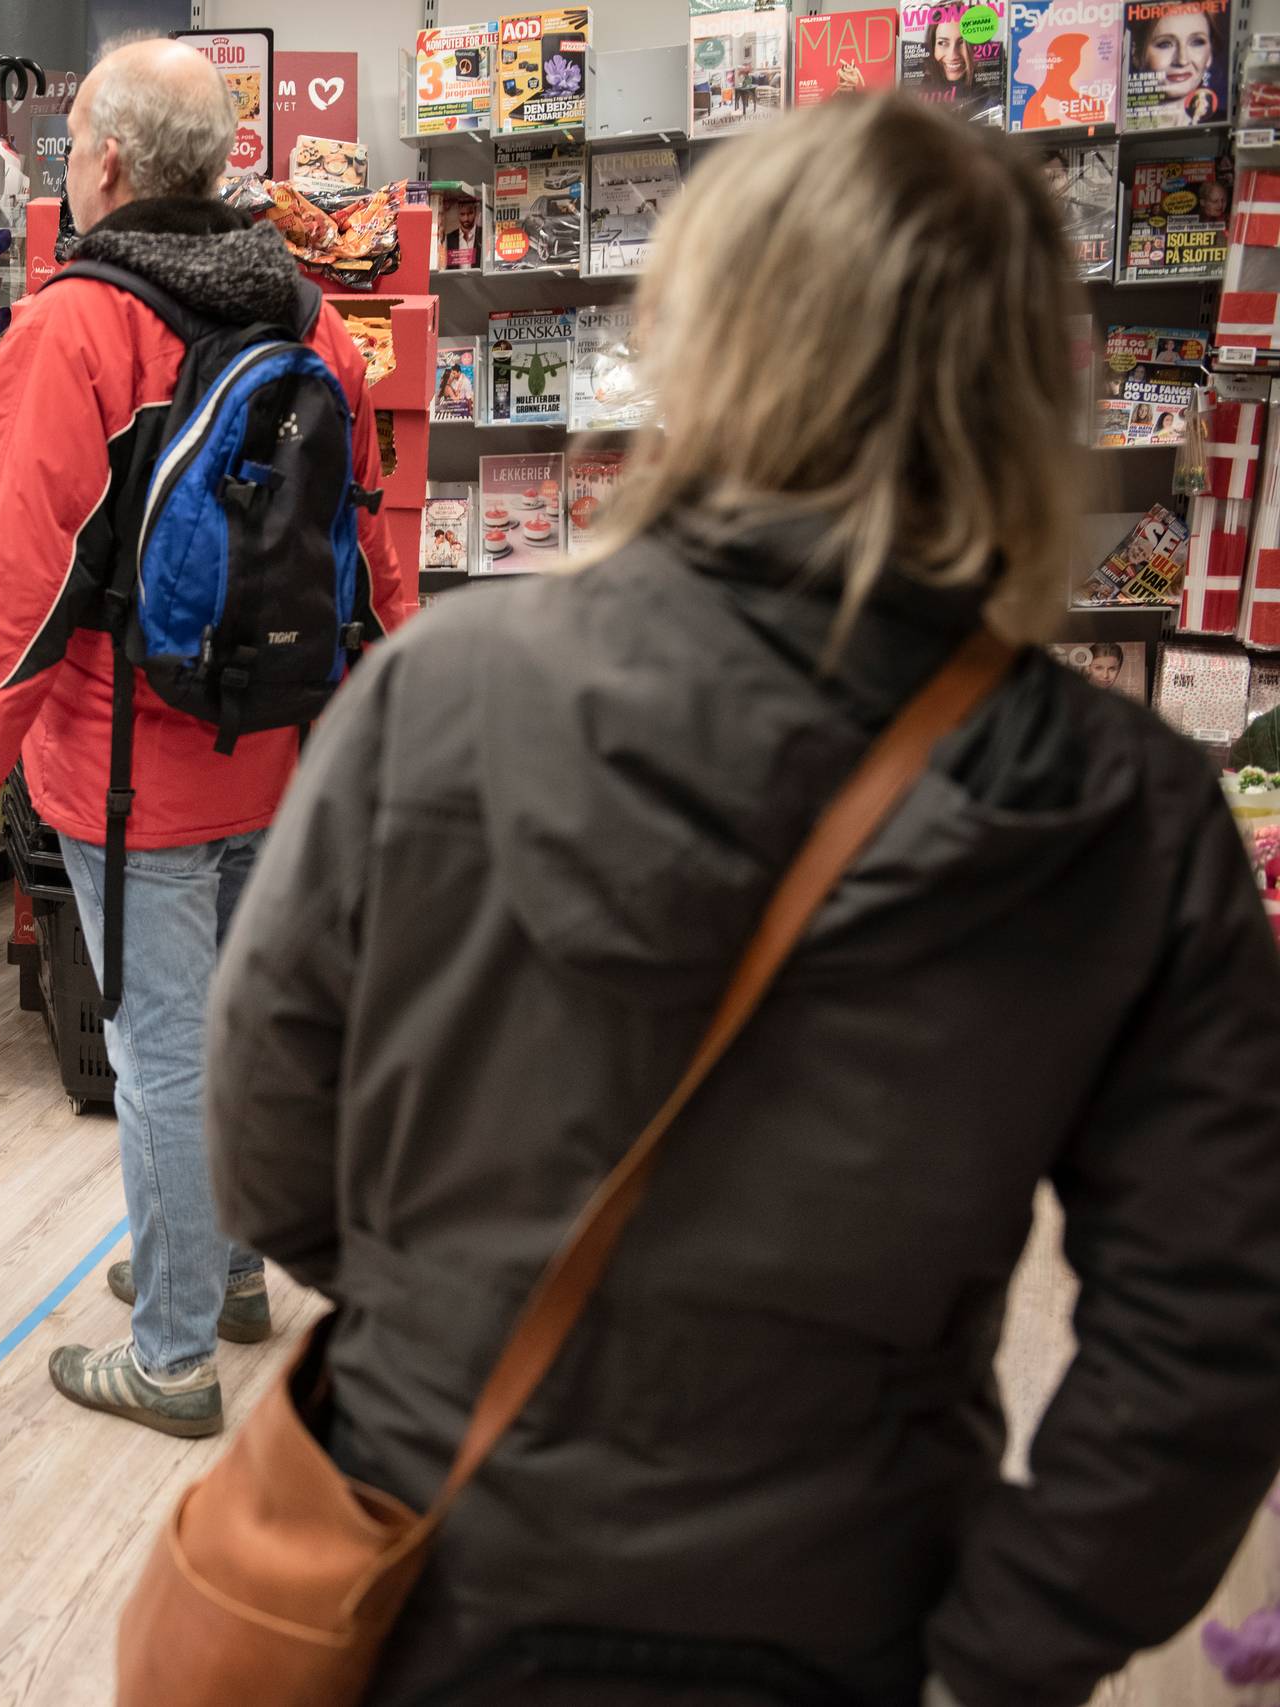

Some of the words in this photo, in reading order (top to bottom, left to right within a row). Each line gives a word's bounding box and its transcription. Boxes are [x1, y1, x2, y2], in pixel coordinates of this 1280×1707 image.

[799, 16, 831, 24] POLITIKEN
[961, 18, 992, 28] WOMAN
[502, 20, 541, 41] AOD
[962, 25, 995, 35] COSTUME
[425, 36, 465, 51] KOMPUTER
[465, 35, 480, 49] FOR
[481, 33, 499, 47] ALLE
[799, 15, 893, 68] MAD
[973, 43, 1000, 58] 207
[418, 61, 444, 101] 3
[798, 79, 818, 87] PASTA
[1079, 84, 1113, 98] FOR
[523, 104, 545, 115] DEN
[546, 100, 585, 114] BEDSTE
[523, 112, 563, 122] FOLDBARE
[497, 155, 510, 163] FOR
[511, 154, 516, 162] 1
[496, 208, 521, 221] AUDI
[499, 239, 526, 249] MAGASIN
[1167, 231, 1217, 248] ISOLERET
[1165, 246, 1181, 265] PÅ
[1182, 247, 1228, 264] SLOTTET
[1137, 267, 1169, 275] Afhængig
[506, 316, 558, 327] ILLUSTRERET
[578, 314, 611, 329] SPIS
[493, 325, 573, 341] VIDENSKAB
[1107, 338, 1128, 348] UDE
[1129, 339, 1146, 348] OG
[1106, 347, 1150, 357] HJEMME
[1124, 382, 1157, 394] HOLDT
[516, 396, 526, 405] NU
[525, 394, 550, 404] LETTER
[550, 394, 561, 403] DEN
[1123, 392, 1142, 401] OG
[516, 404, 541, 414] GRØNNE
[541, 403, 561, 412] FLADE
[493, 466, 551, 482] LÆKKERIER
[1150, 554, 1179, 577] ULF
[1140, 567, 1169, 592] VAR
[268, 630, 298, 645] TIGHT
